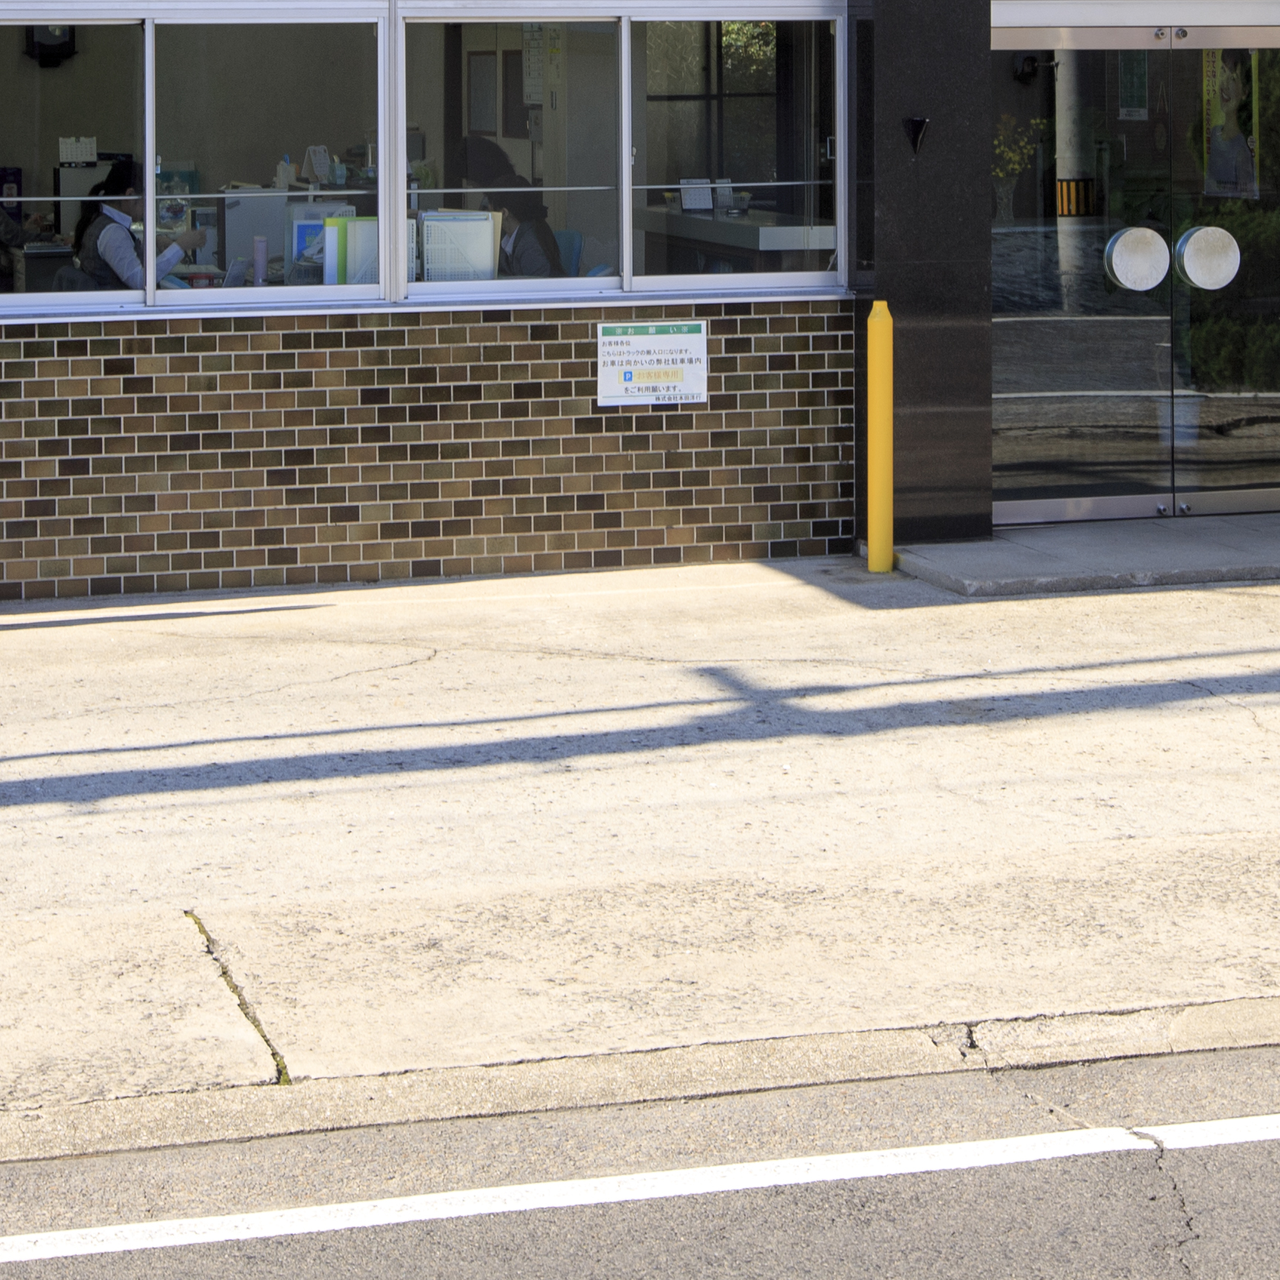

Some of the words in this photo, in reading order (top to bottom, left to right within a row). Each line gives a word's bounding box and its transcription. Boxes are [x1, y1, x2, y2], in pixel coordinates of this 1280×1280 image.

[624, 385, 682, 394] をご利用願います。
